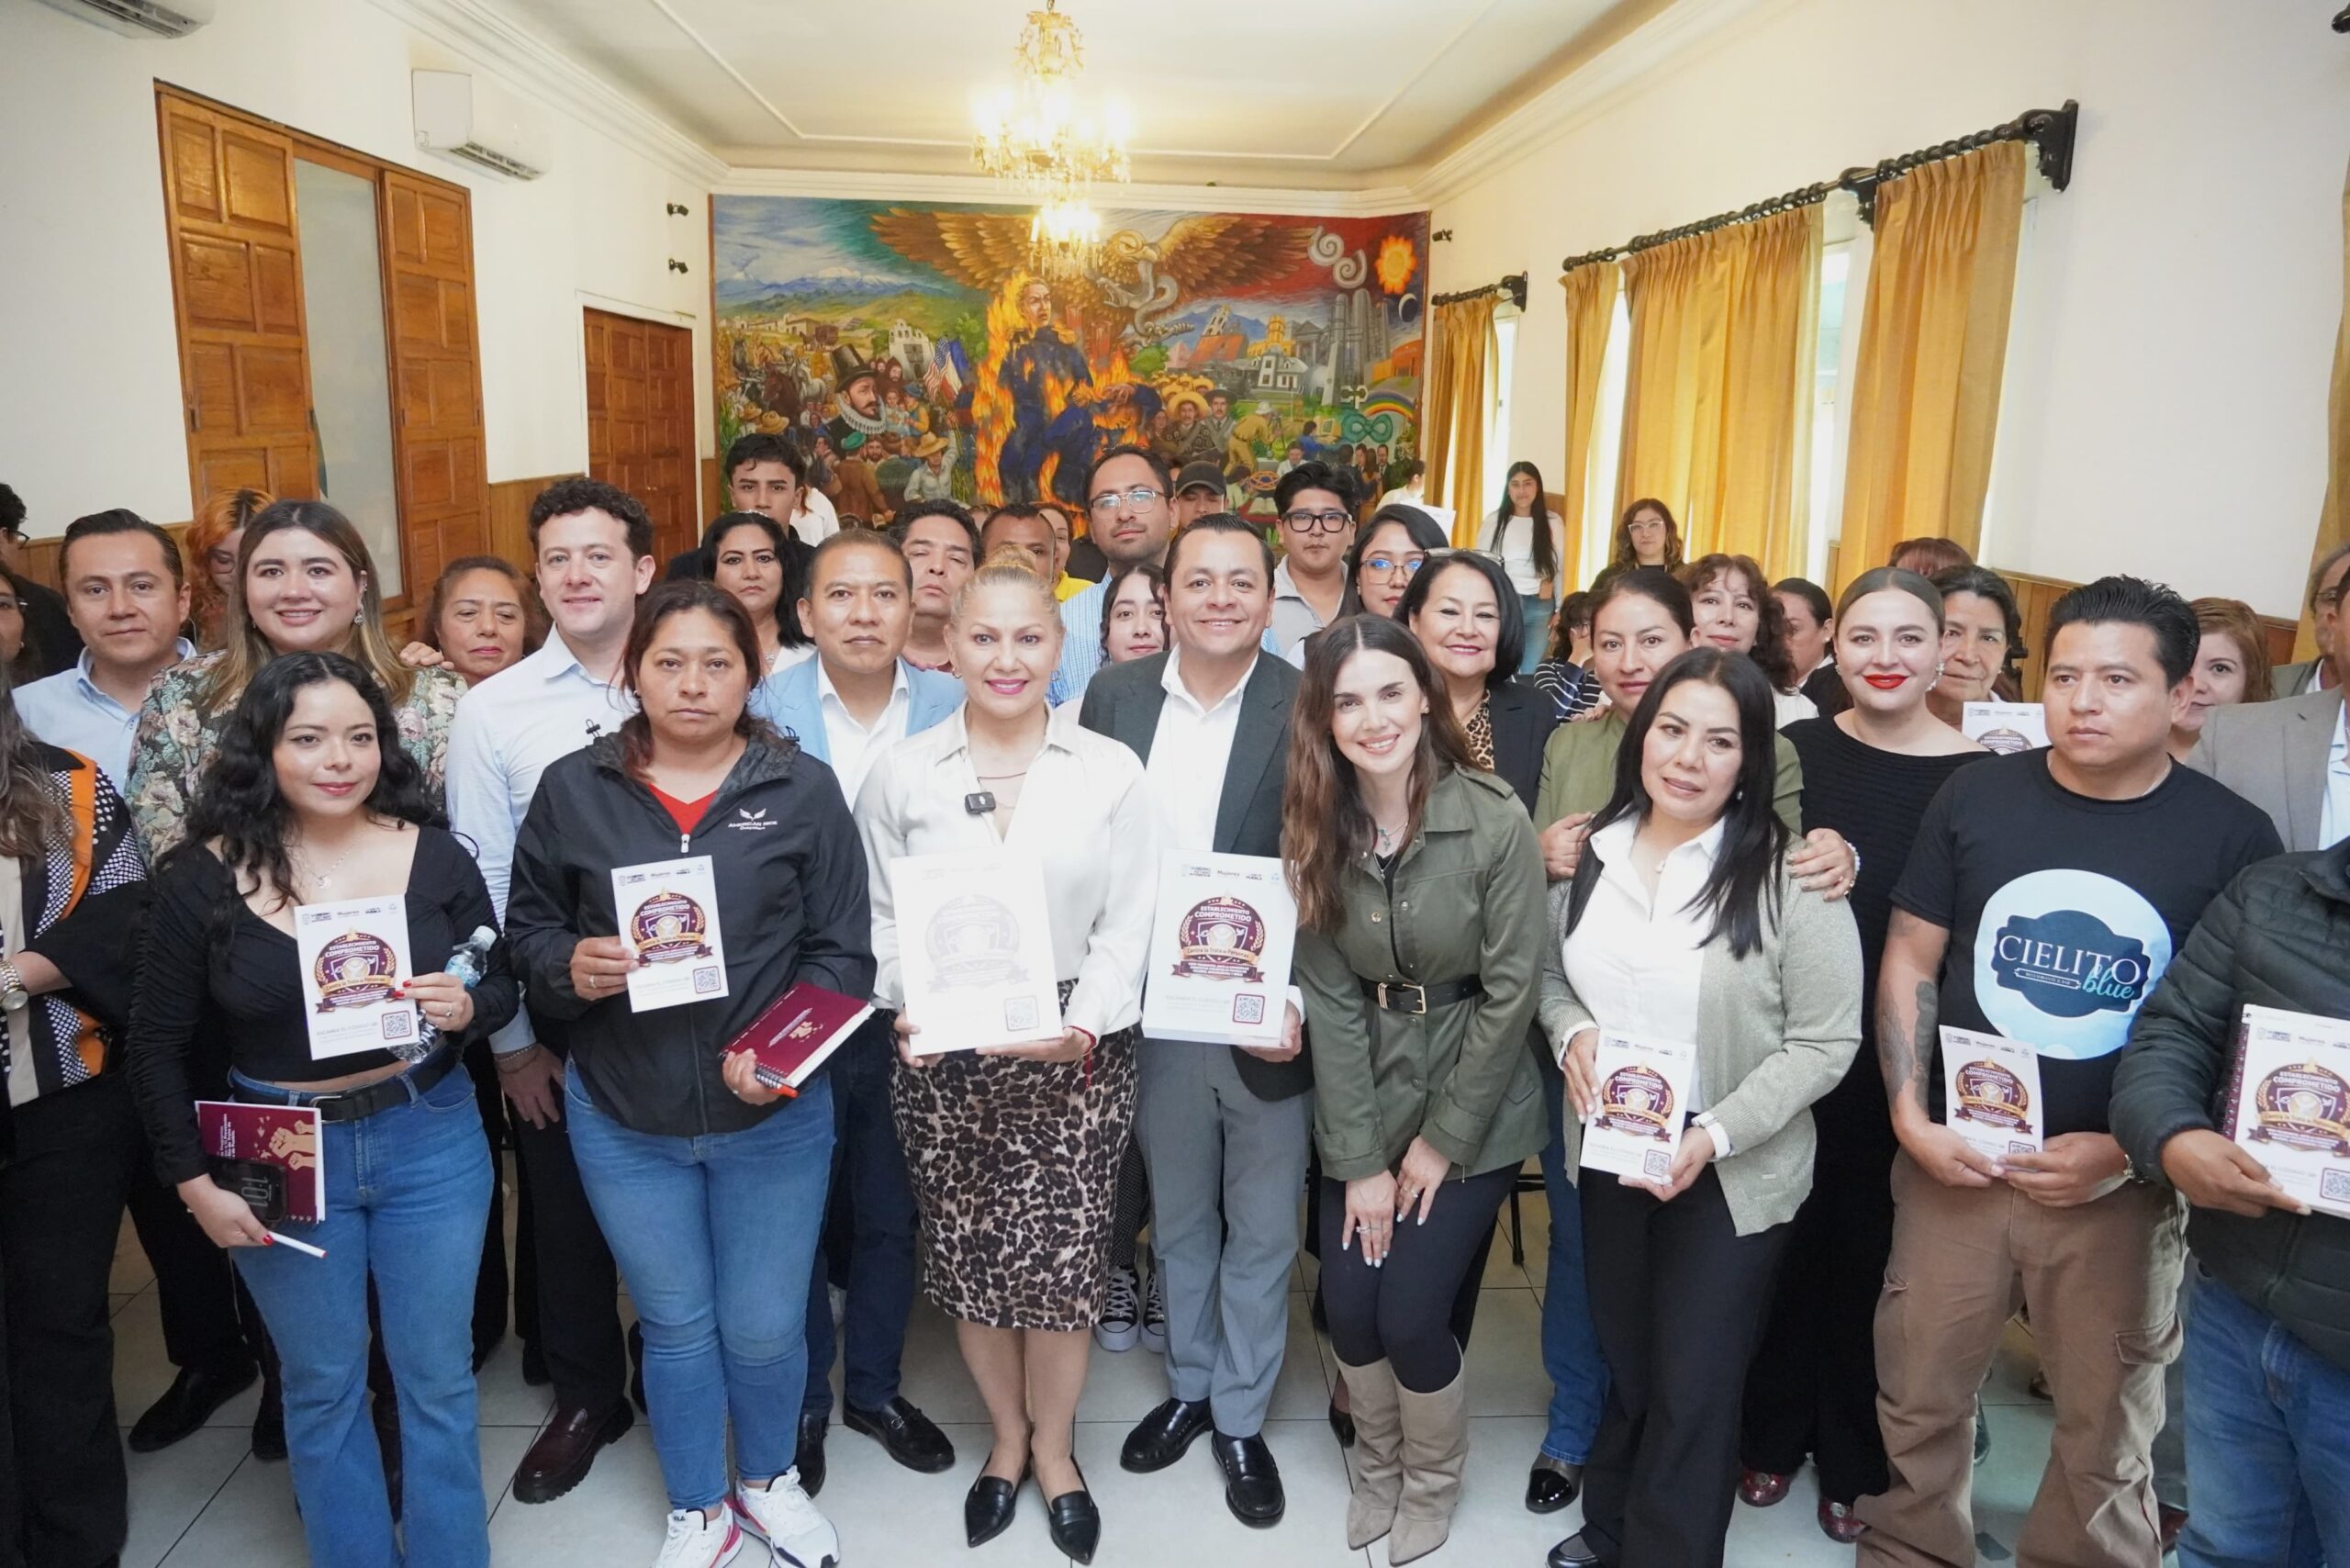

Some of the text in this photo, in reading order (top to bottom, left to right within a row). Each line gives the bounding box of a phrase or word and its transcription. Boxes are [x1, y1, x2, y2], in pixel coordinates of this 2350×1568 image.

[640, 904, 690, 917] COMPROMETIDO
[1194, 911, 1252, 923] COMPROMETIDO
[1200, 905, 1250, 915] ESTABLECIMIENTO
[325, 945, 380, 958] COMPROMETIDO
[329, 939, 377, 951] ESTABLECIMIENTO
[1998, 935, 2141, 986] CIELITO
[2082, 964, 2135, 1000] blue
[1614, 1075, 1664, 1090] COMPROMETIDO
[1964, 1070, 2013, 1084] COMPROMETIDO
[2272, 1076, 2341, 1092] COMPROMETIDO
[2278, 1071, 2339, 1085] ESTABLECIMIENTO
